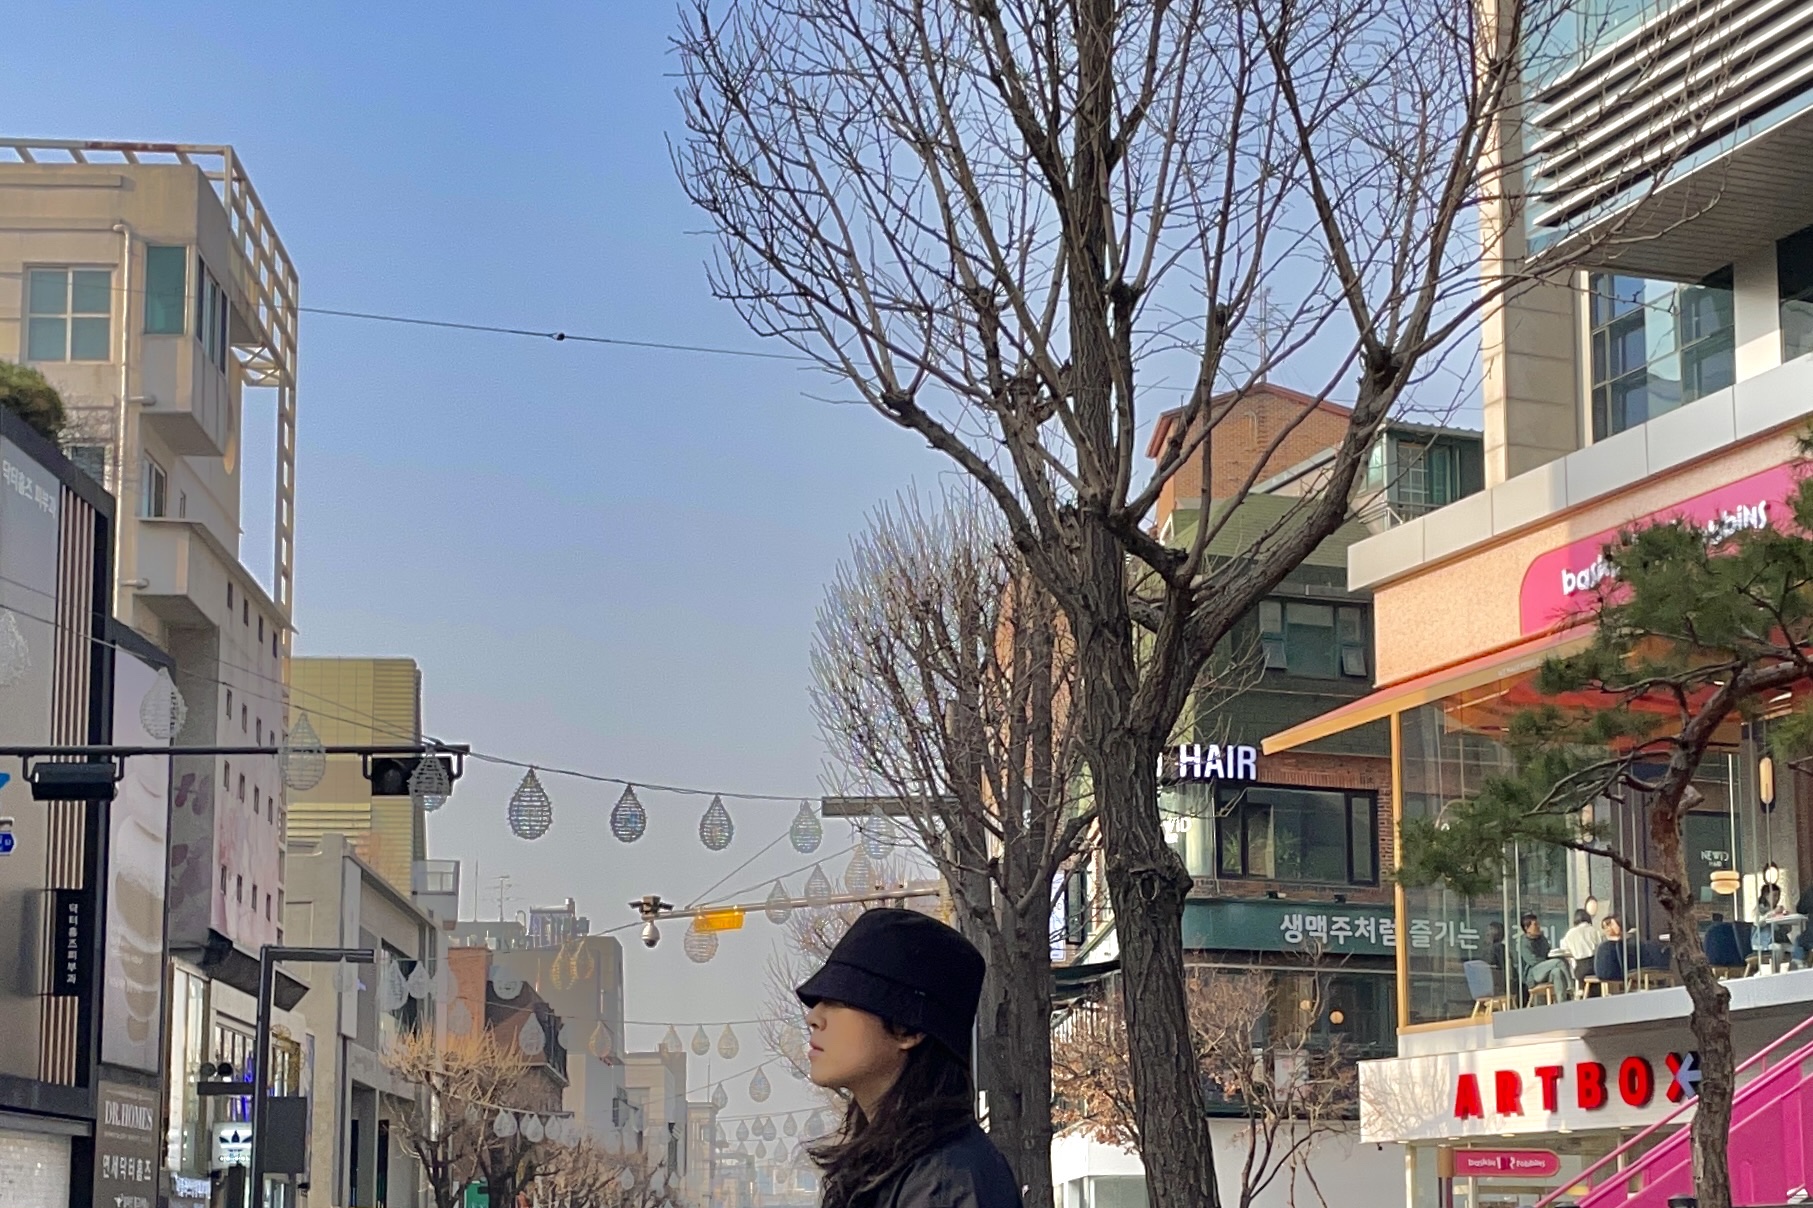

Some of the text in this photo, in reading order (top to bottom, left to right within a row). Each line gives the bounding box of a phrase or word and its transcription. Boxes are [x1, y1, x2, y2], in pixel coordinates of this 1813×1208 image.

[1179, 743, 1257, 780] HAIR
[1280, 913, 1396, 945] 생맥주처럼
[1409, 918, 1480, 950] 즐기는
[1454, 1051, 1701, 1119] ARTBOX
[103, 1154, 152, 1182] 연세닥터홈즈
